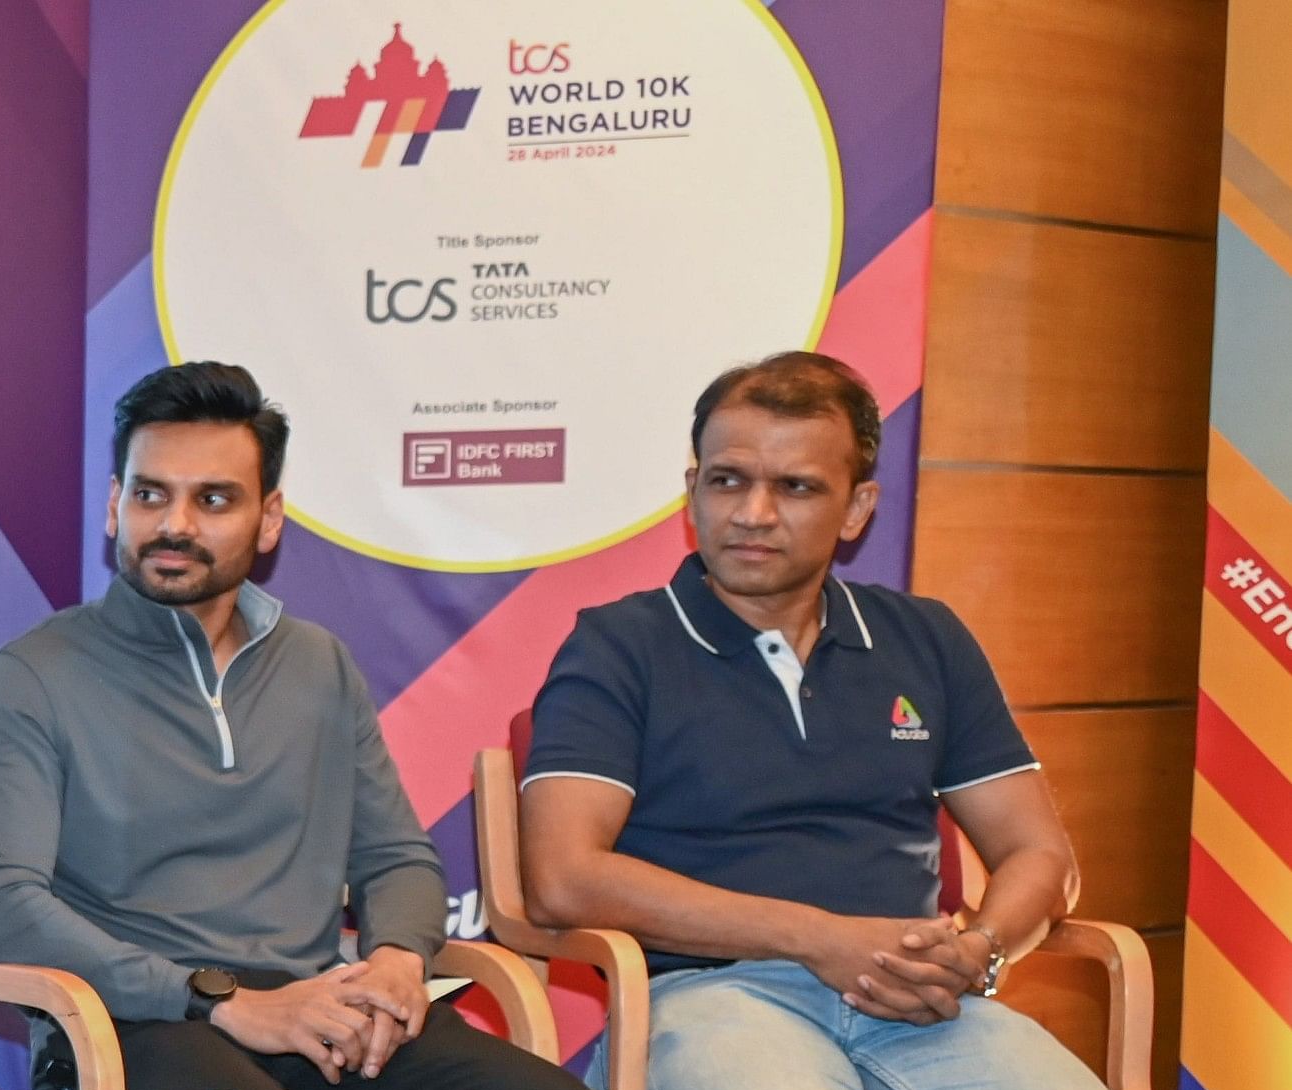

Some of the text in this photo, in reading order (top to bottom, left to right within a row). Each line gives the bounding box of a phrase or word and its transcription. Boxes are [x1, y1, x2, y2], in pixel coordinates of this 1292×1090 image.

[509, 39, 570, 74] tcs
[509, 75, 690, 105] WORLD 10K
[508, 107, 692, 138] BENGALURU
[508, 144, 617, 162] 28 April 2024
[437, 233, 540, 249] Title Sponsor
[472, 262, 530, 278] TATA
[366, 269, 456, 324] tcs
[471, 278, 612, 300] CONSULTANCY
[471, 301, 559, 321] SERVICES
[412, 399, 558, 416] Associate Sponsor
[458, 440, 558, 463] IDFC FIRST
[457, 461, 503, 480] Bank
[1220, 557, 1292, 652] #En
